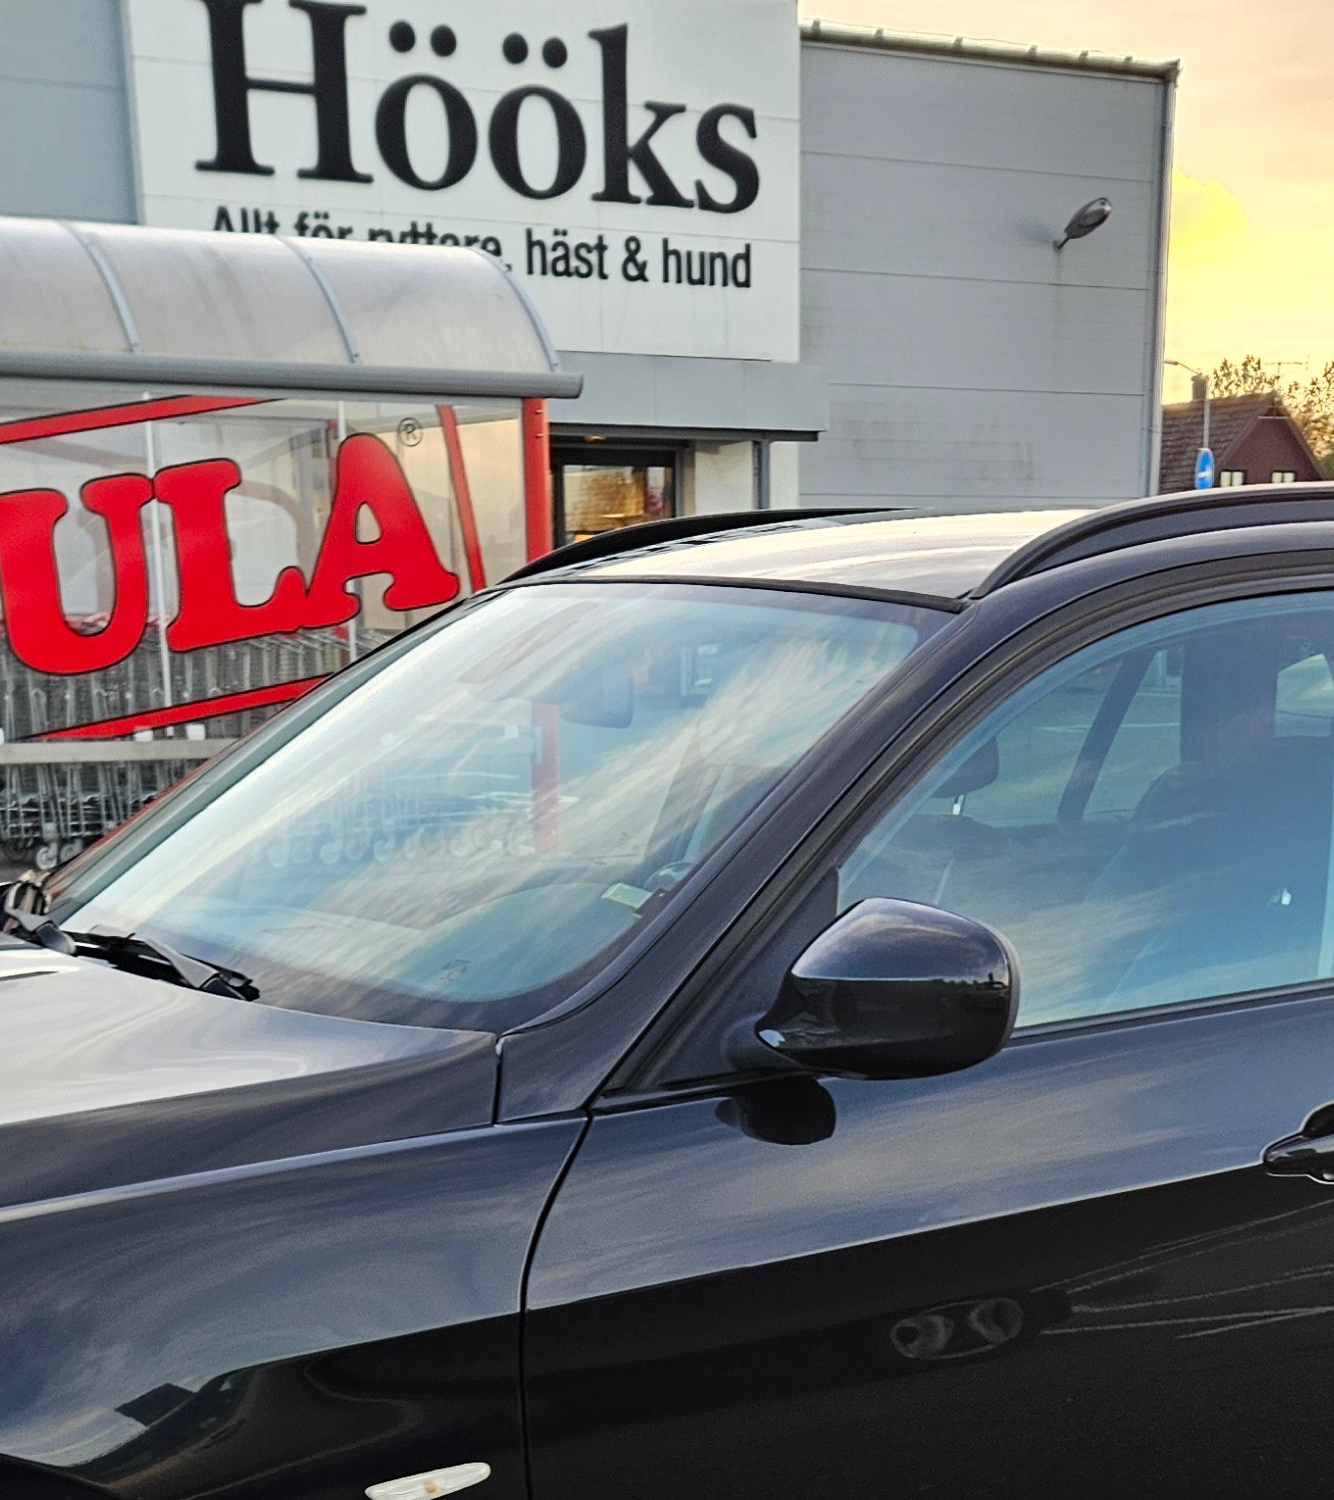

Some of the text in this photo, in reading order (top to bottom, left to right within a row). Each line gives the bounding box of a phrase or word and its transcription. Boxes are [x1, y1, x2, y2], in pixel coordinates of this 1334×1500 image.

[194, 0, 760, 215] Hööks
[525, 228, 609, 280] häst
[622, 236, 649, 282] &
[663, 237, 751, 288] hund
